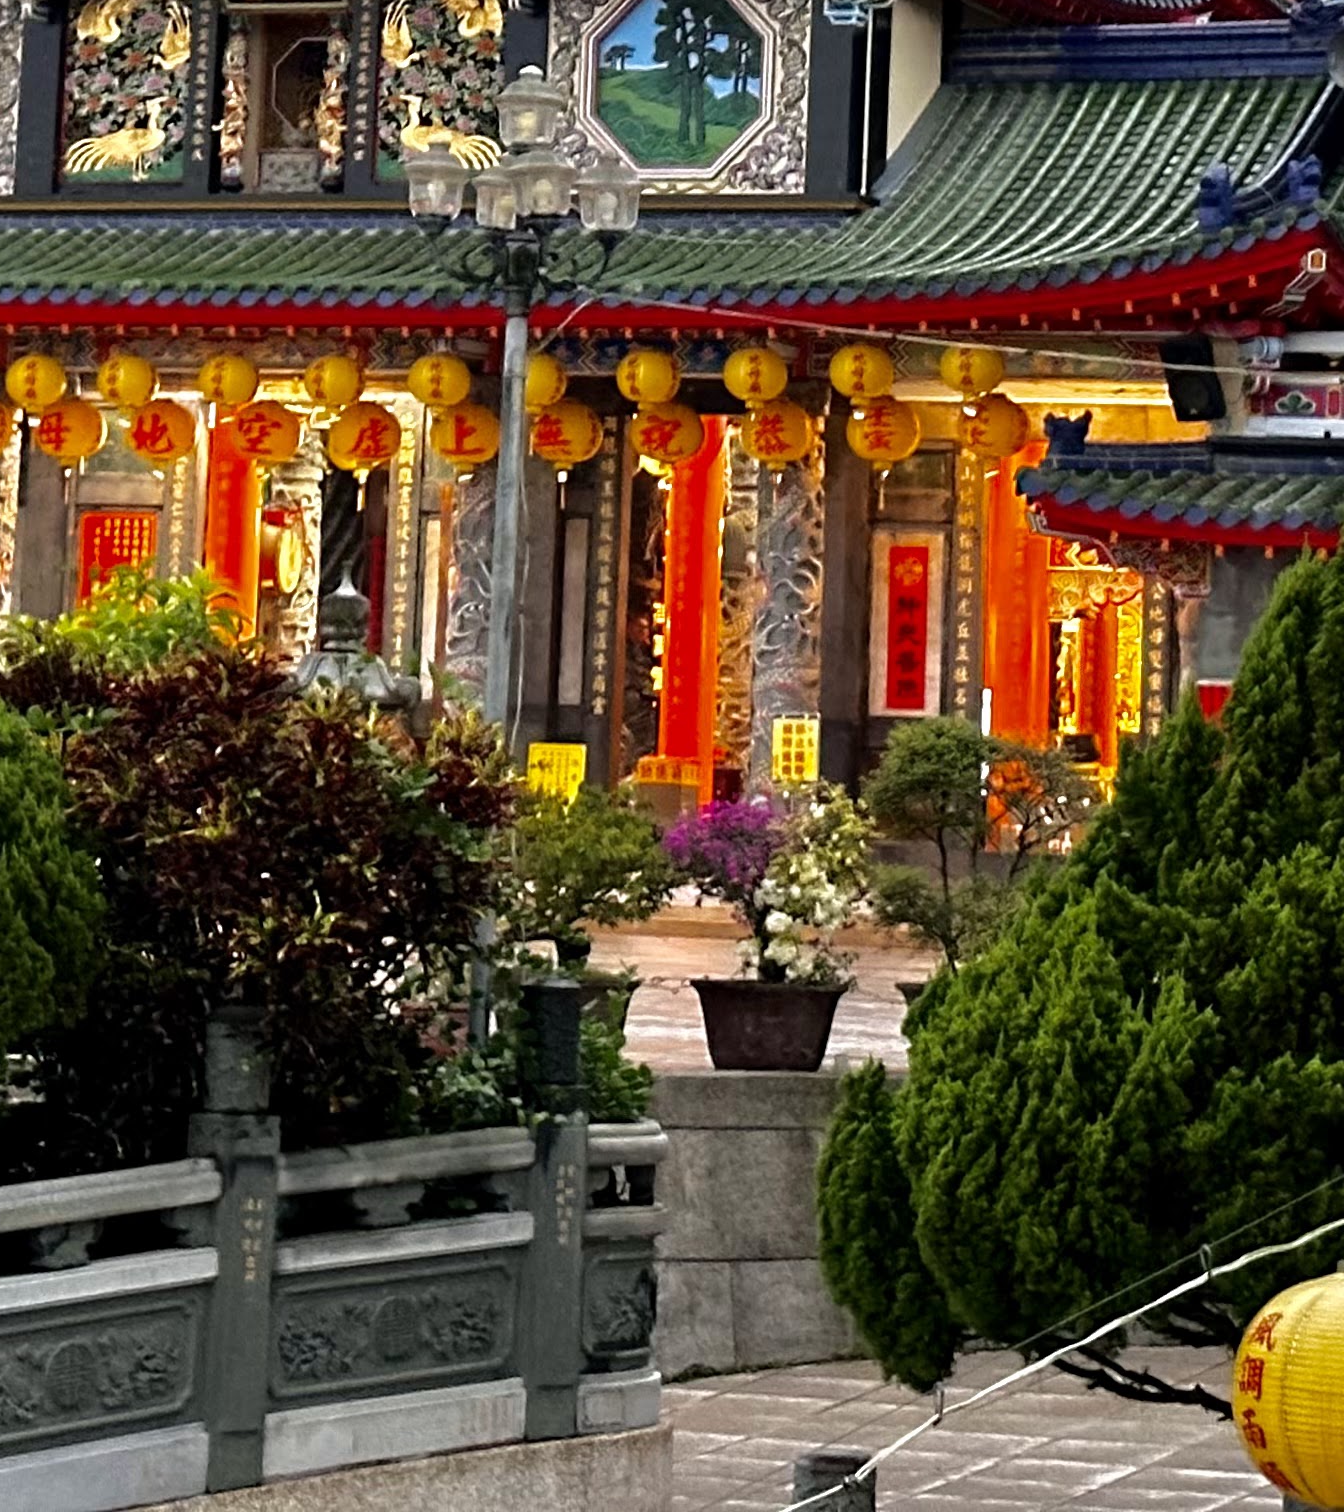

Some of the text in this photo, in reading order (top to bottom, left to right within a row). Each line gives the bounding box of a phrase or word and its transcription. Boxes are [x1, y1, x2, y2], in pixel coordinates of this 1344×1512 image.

[38, 412, 71, 451] 母
[132, 413, 174, 454] 地
[237, 413, 282, 455] 空
[443, 414, 483, 456] 上
